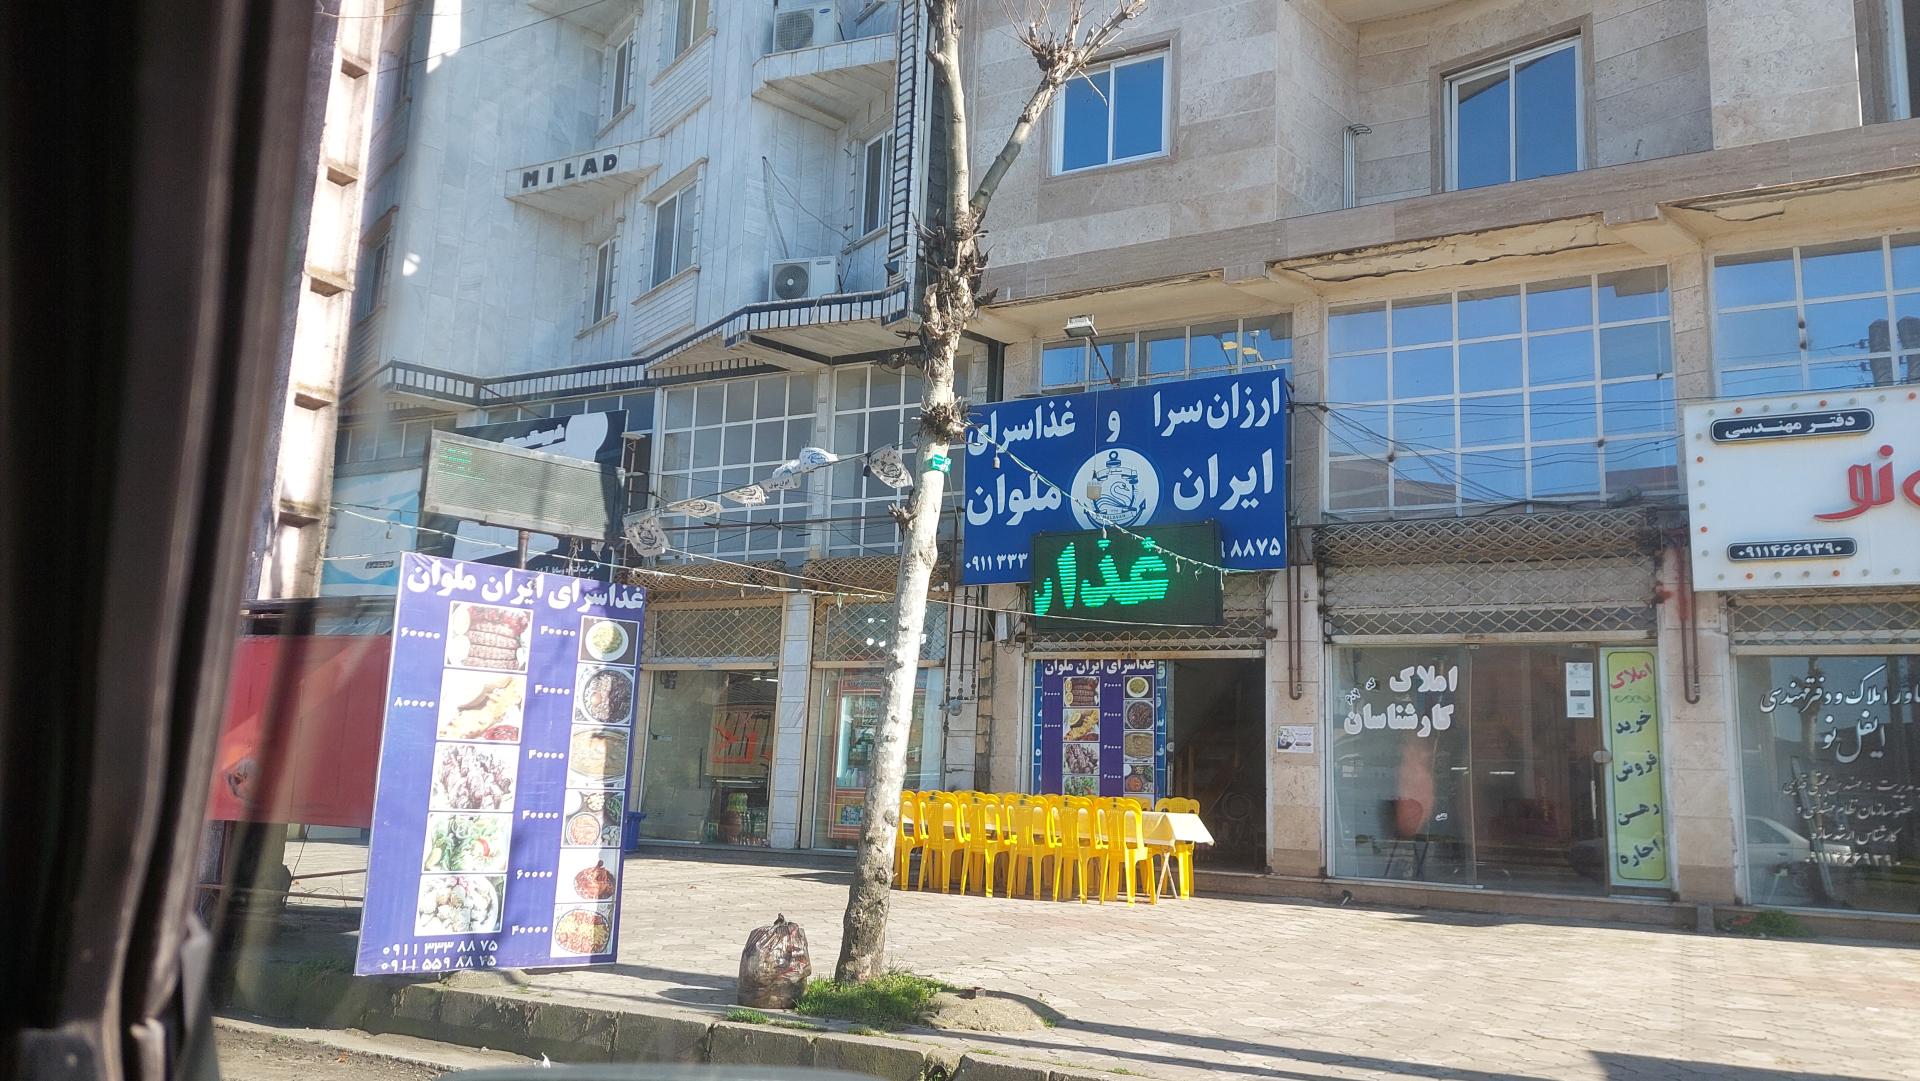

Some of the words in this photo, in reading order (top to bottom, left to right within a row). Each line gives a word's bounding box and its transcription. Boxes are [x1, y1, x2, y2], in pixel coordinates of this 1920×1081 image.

[522, 154, 618, 188] MILAD
[1153, 391, 1202, 437] سرا
[1206, 377, 1281, 430] ارزان
[967, 400, 1076, 456] غذاسرای
[1105, 410, 1121, 443] و
[1725, 420, 1802, 439] مهندسی
[1806, 413, 1856, 433] دفتر
[1173, 448, 1274, 511] ایران
[966, 471, 1062, 526] ملوان
[965, 553, 993, 572] ۰۹۱۱
[996, 551, 1028, 569] ۳۳۳
[1231, 538, 1281, 558] ۸۸۷۵
[1738, 542, 1842, 557] ۰۹۱۱۴۶۶۹۳۹۰
[407, 560, 477, 596] ملوان
[481, 569, 544, 605] ایران
[549, 577, 644, 613] غذاسرای
[1044, 660, 1074, 675] ملوان
[1389, 665, 1458, 692] املاک
[1610, 662, 1653, 689] املاک
[1845, 664, 1888, 705] املاک
[394, 696, 435, 708] ۸۰۰۰۰
[1344, 703, 1455, 737] کارشناسان
[1615, 710, 1652, 735] خرید
[1822, 715, 1838, 750] نو
[1836, 710, 1886, 763] ایفل
[1616, 750, 1659, 782] فروش
[1618, 802, 1660, 826] رهن
[1619, 838, 1662, 867] اجاره
[381, 959, 416, 972] ۰۹۱۱
[422, 957, 451, 970] ۵۵۹
[455, 956, 474, 968] ۸۸
[383, 943, 418, 956] ۰۹۱۱
[424, 941, 454, 955] ۳۳۳
[457, 940, 476, 953] ۸۸
[480, 940, 498, 952] ۷۵
